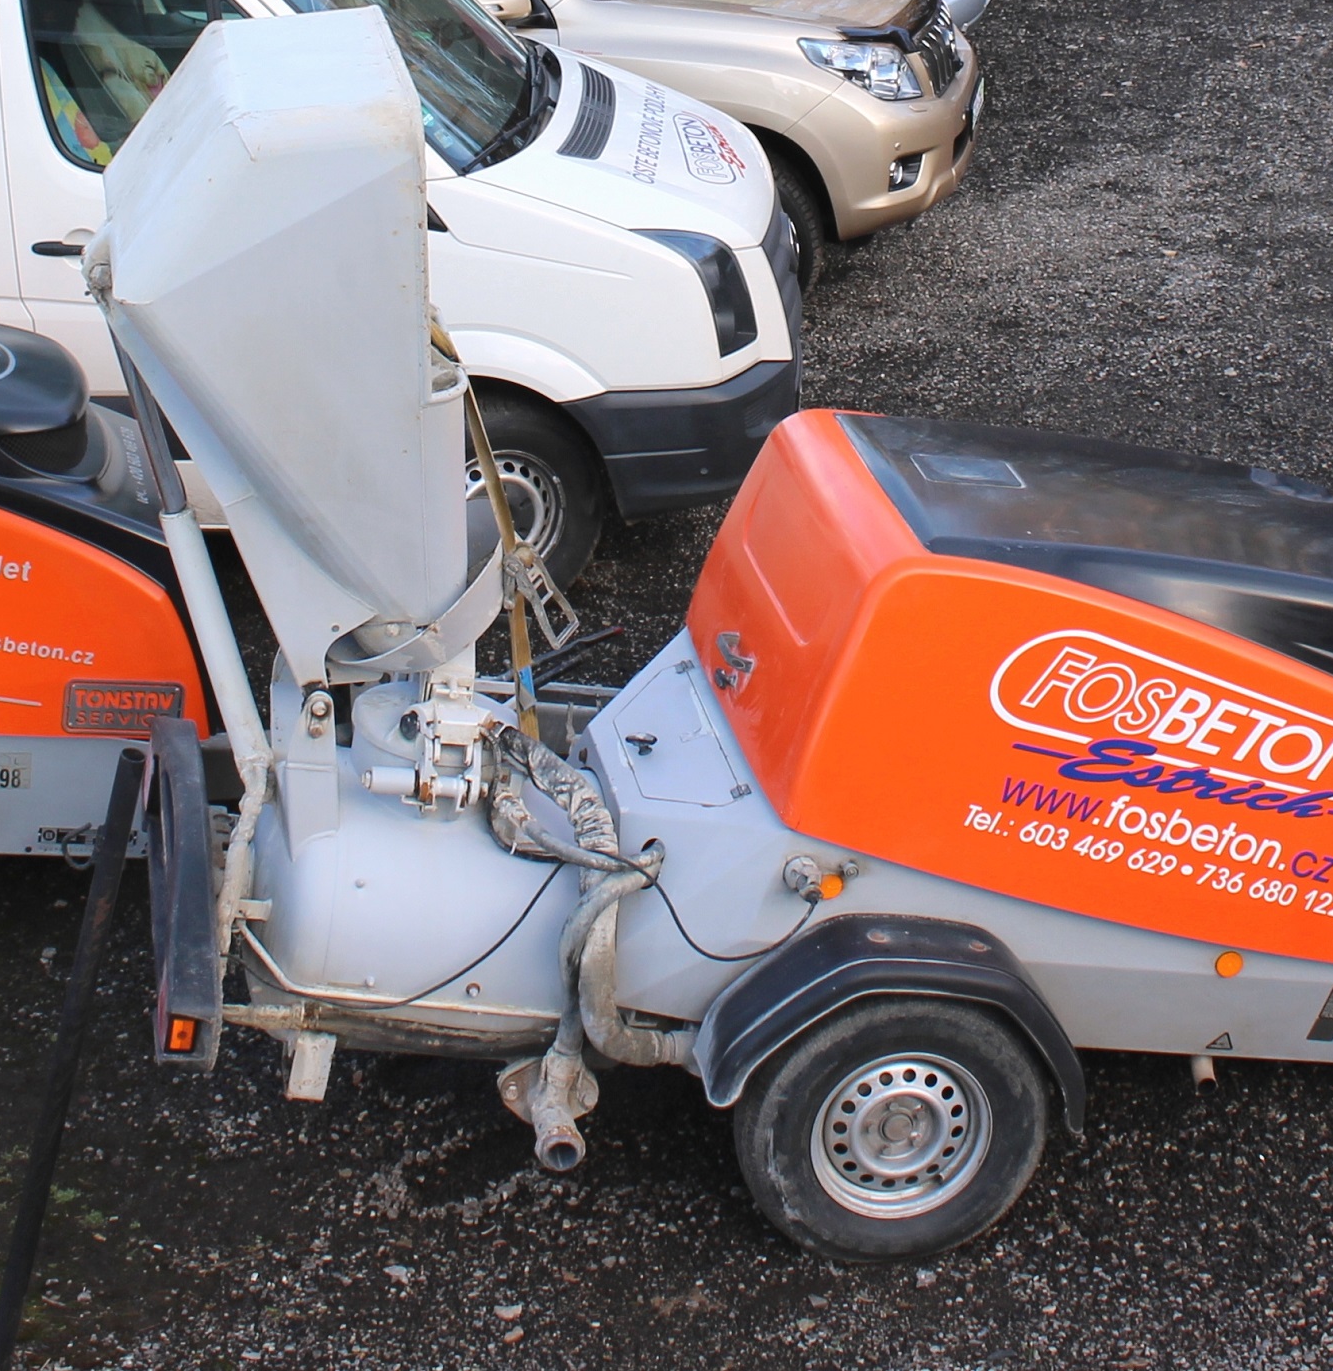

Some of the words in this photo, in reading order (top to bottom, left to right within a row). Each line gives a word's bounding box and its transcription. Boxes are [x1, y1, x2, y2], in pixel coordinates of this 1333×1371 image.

[678, 116, 728, 179] FOSBETON
[75, 689, 176, 710] TONSTAV
[76, 711, 169, 727] SERVIC
[0, 768, 22, 788] 98
[963, 804, 1015, 837] Tel.:
[1018, 820, 1070, 851] 603
[1073, 835, 1125, 864] 469
[1248, 877, 1298, 907] 680
